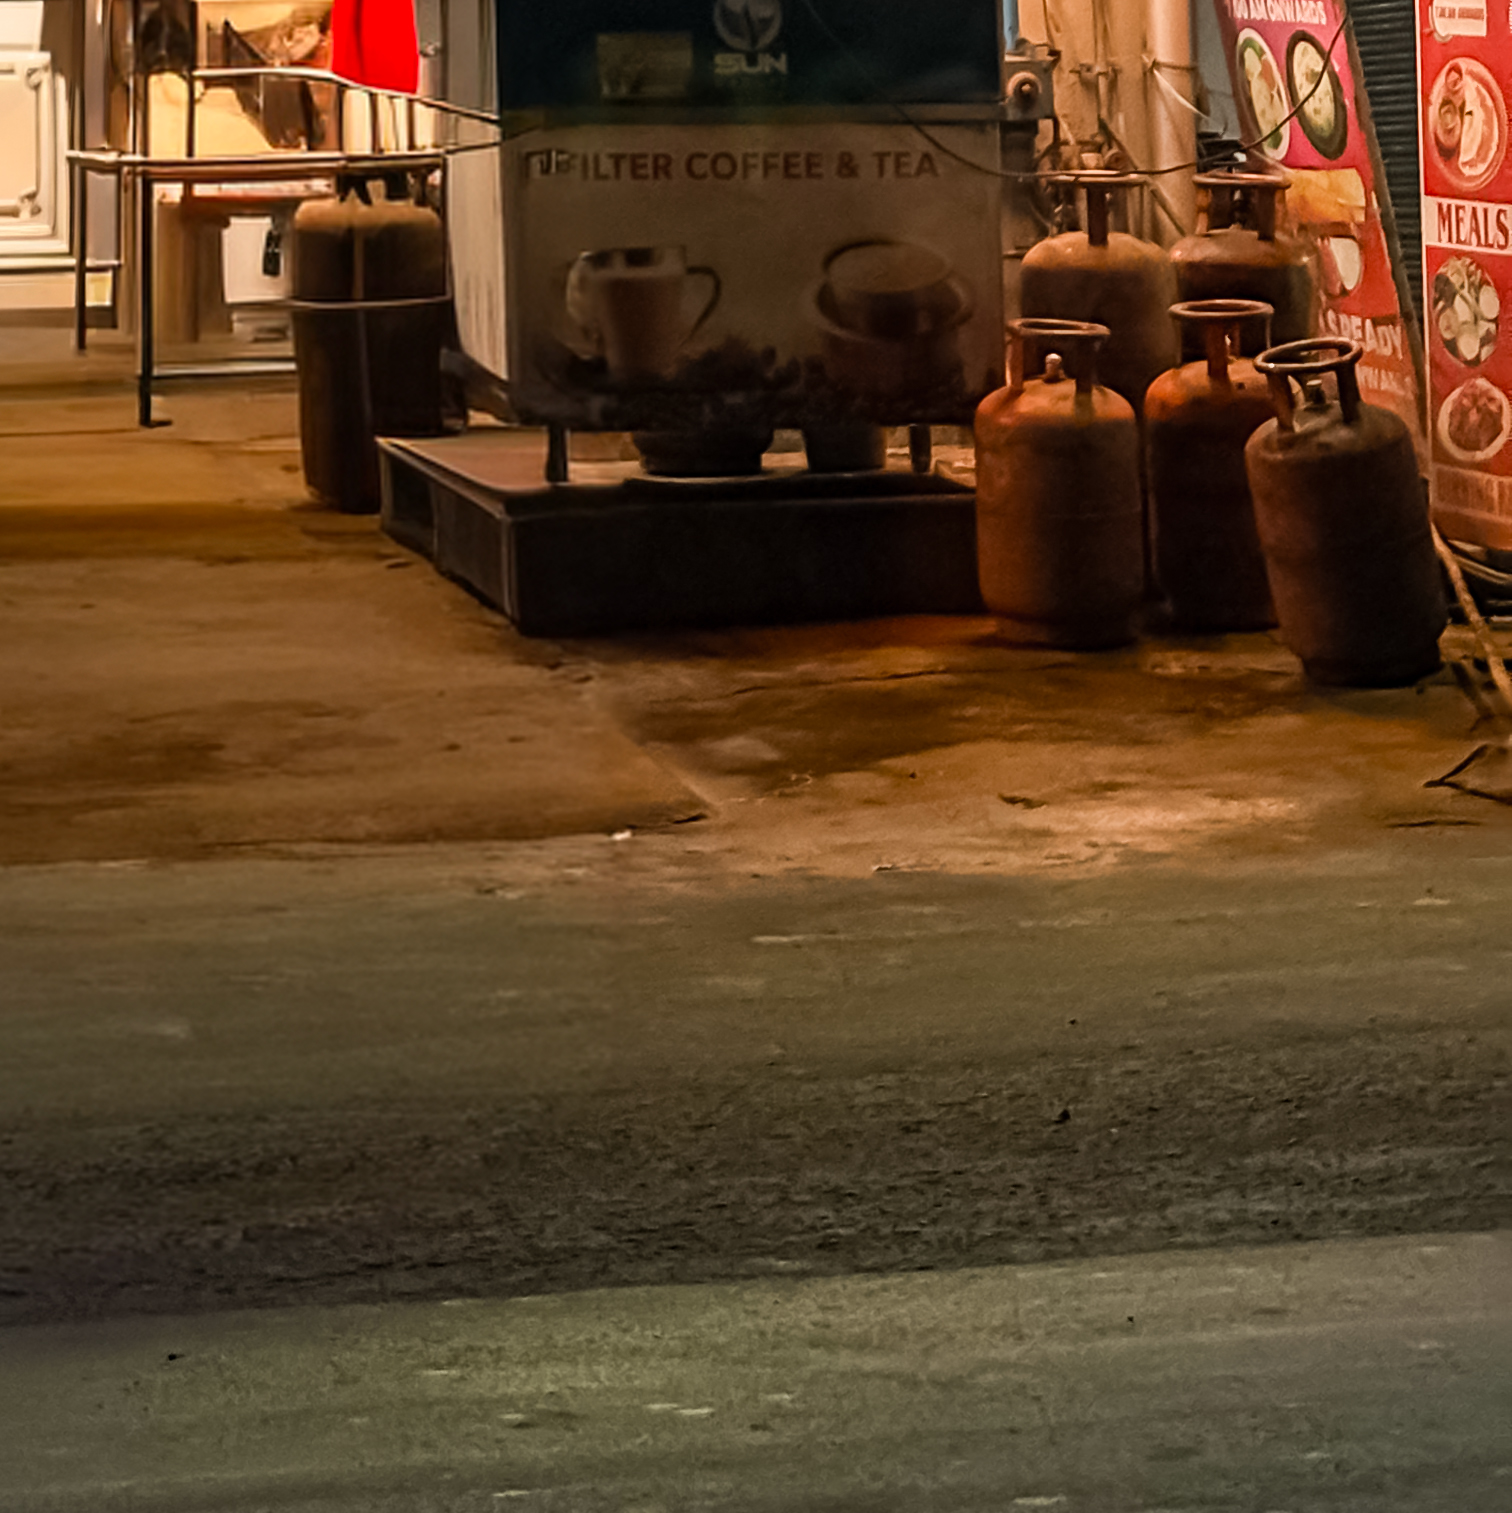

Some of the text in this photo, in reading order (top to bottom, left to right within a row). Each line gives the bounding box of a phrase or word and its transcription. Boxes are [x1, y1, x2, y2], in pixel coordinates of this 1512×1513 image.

[714, 53, 787, 74] SUN
[684, 152, 825, 181] COFFEE
[835, 151, 860, 180] &
[871, 151, 941, 180] TEA
[1437, 201, 1511, 251] MEALS
